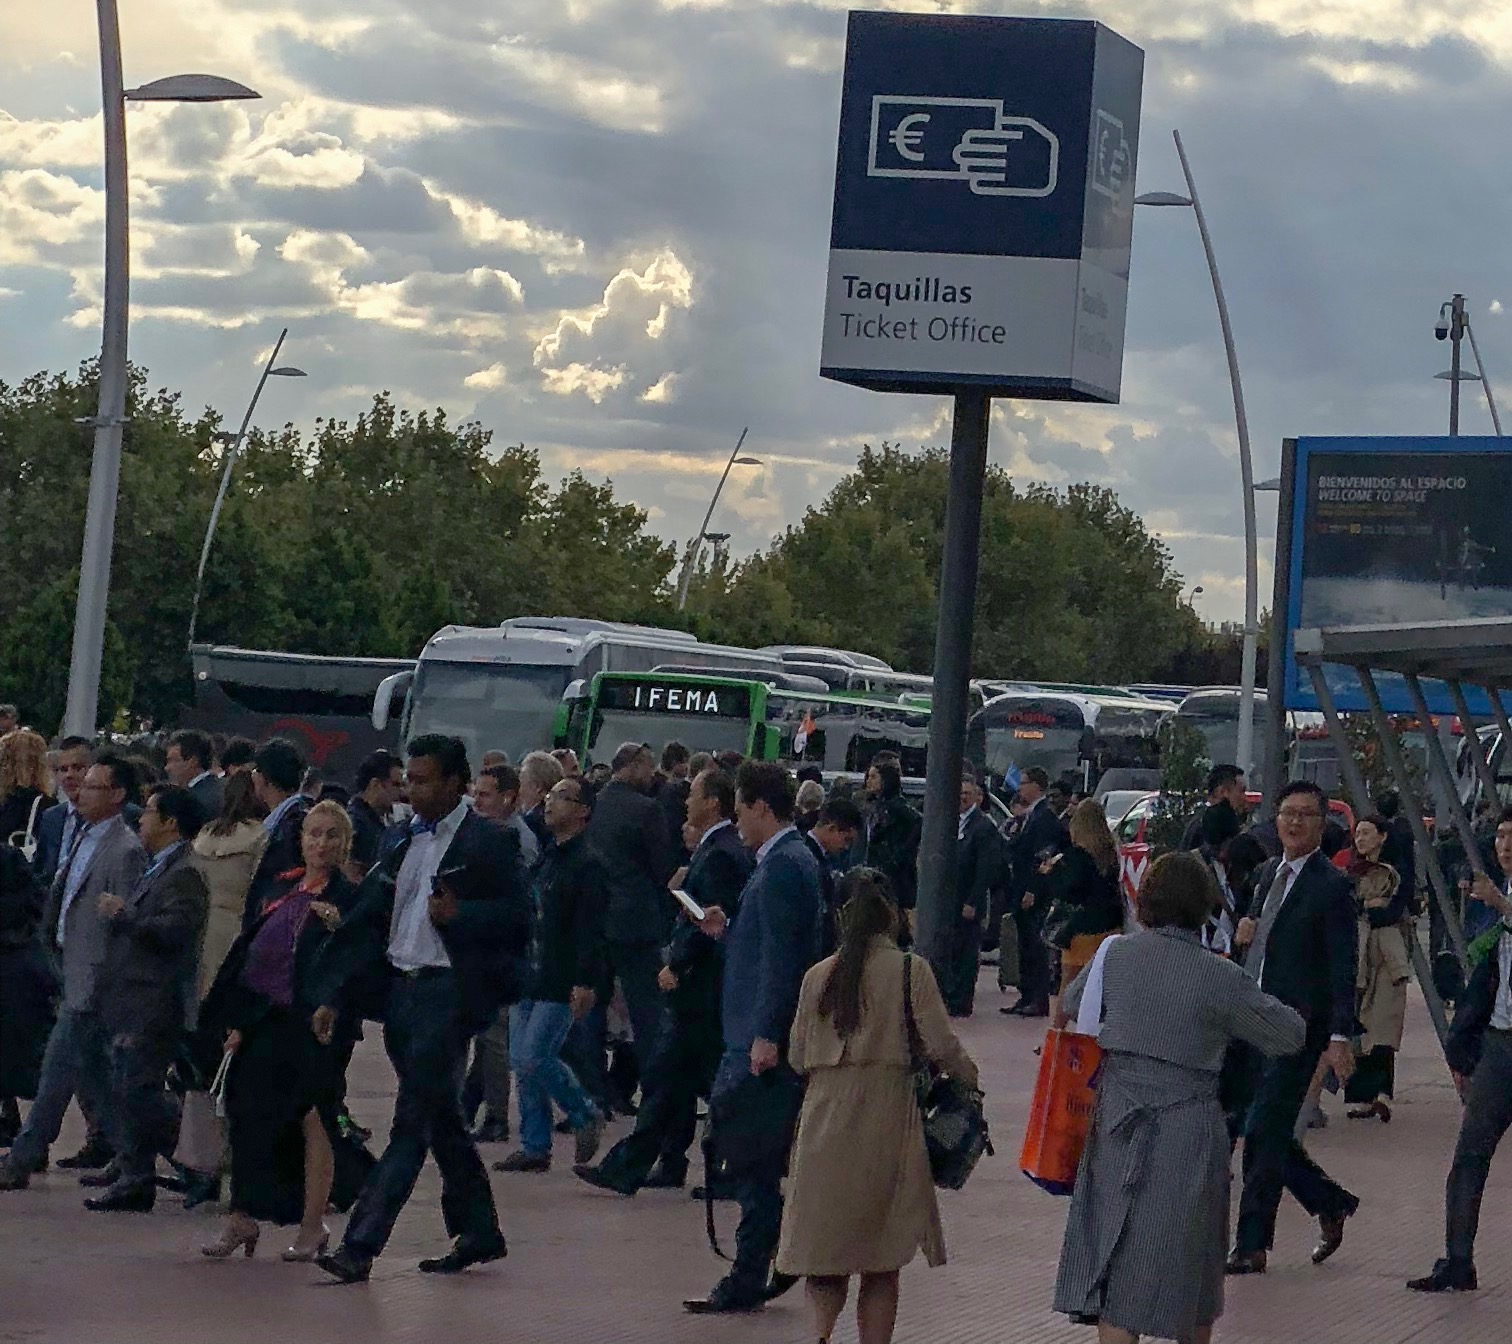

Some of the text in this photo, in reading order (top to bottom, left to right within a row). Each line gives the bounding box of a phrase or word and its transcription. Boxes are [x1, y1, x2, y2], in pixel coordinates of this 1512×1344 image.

[842, 275, 972, 306] Taquillas
[840, 313, 1007, 344] Ticket Office
[1318, 475, 1467, 490] BIENVENIDOS AL ESPACIO
[1318, 489, 1428, 503] WELCOME TO SPACE
[634, 686, 718, 713] IFEMA
